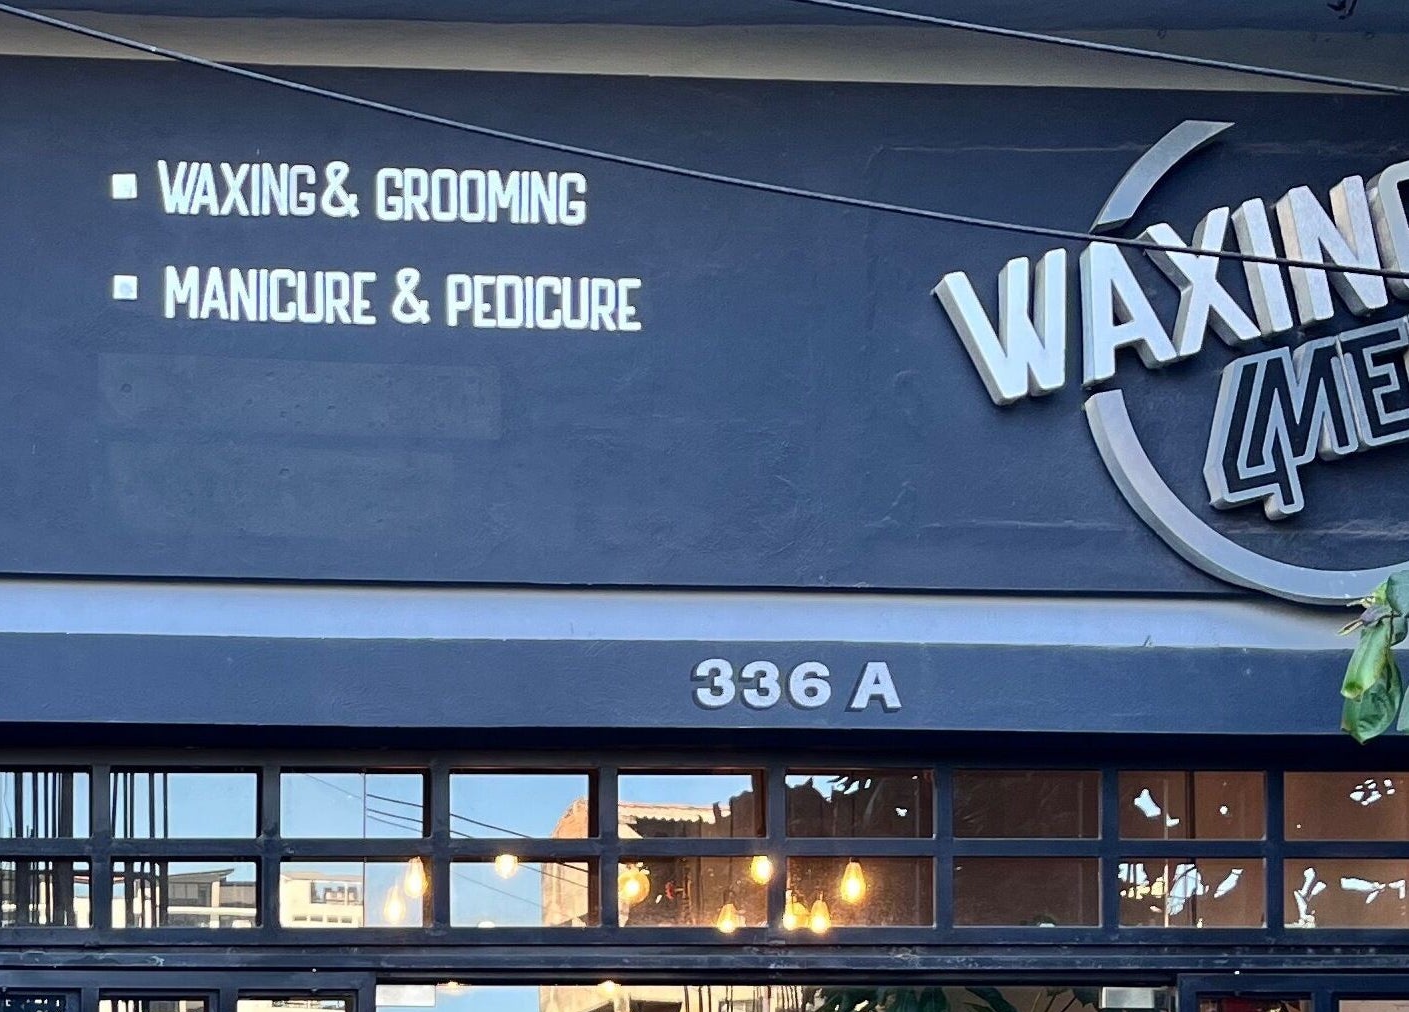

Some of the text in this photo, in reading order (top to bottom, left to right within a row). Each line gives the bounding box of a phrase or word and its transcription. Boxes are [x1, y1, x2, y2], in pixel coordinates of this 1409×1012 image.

[376, 167, 587, 226] GROOMING
[164, 266, 642, 331] MANICURE & PEDICURE
[1203, 318, 1409, 520] 4ME
[693, 659, 902, 710] 336 A
